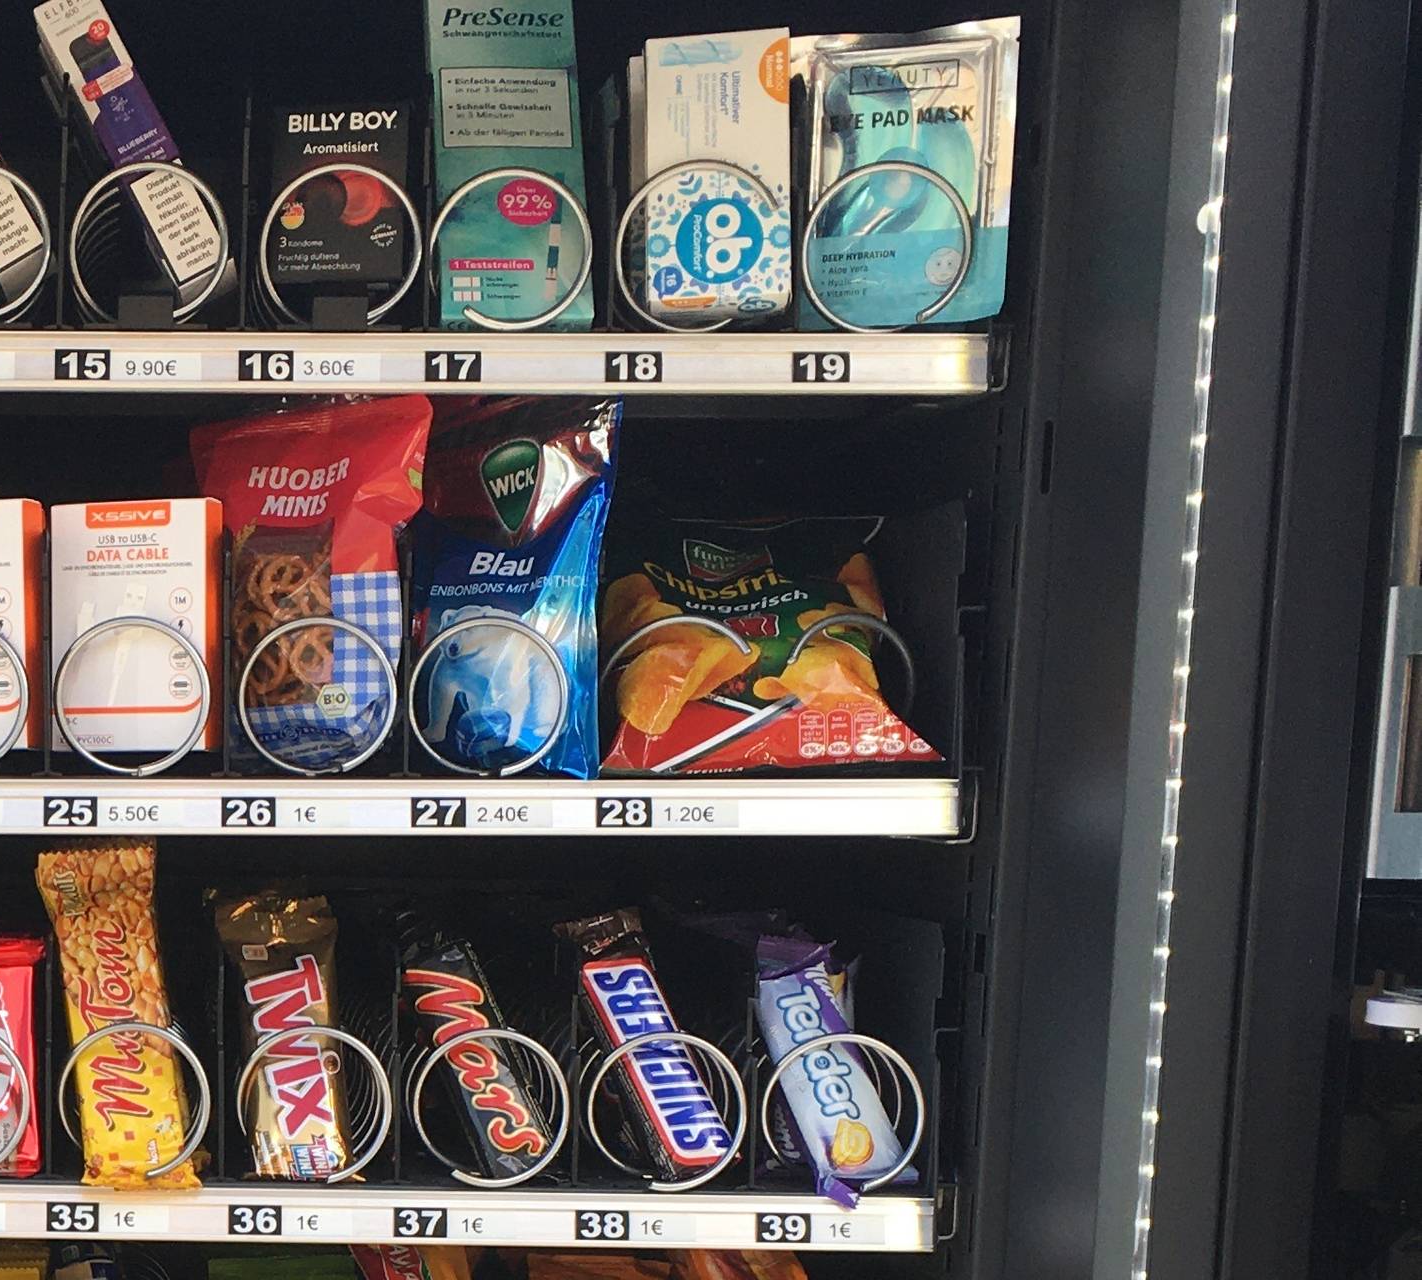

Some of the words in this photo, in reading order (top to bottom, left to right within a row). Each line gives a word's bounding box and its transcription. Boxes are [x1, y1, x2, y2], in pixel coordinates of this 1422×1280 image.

[443, 7, 564, 27] PreSense
[455, 77, 496, 86] Einfache
[499, 78, 556, 87] Anwendung
[456, 103, 496, 111] Schnelle
[871, 110, 909, 129] PAD
[916, 105, 975, 124] MASK
[288, 112, 345, 133] BILLY
[349, 110, 398, 130] BOY
[117, 128, 158, 154] BLUEBERRY
[303, 141, 379, 155] Aromatisiert
[279, 237, 287, 248] 3
[692, 214, 703, 271] ProComfort
[465, 261, 530, 269] Teststreifen
[822, 253, 844, 263] DEEP
[845, 250, 896, 263] HYDRATION
[60, 352, 106, 379] 15
[125, 360, 177, 376] 9.90€
[245, 353, 290, 380] 16
[303, 360, 355, 376] 3.60€
[430, 353, 477, 380] 17
[611, 353, 658, 381] 18
[798, 353, 845, 381] 19
[247, 457, 350, 492] HUOBER
[488, 465, 536, 499] WICK
[91, 509, 166, 522] XSSIVE
[261, 492, 329, 518] MINIS
[98, 535, 116, 545] USB
[130, 533, 157, 543] USB-C
[86, 549, 123, 563] DATA
[126, 547, 169, 561] CABLE
[469, 551, 535, 577] Blau
[506, 583, 529, 594] MIT
[685, 590, 809, 613] ungarisch
[47, 799, 94, 825] 25
[108, 805, 160, 822] 5.50€
[225, 799, 272, 825] 26
[295, 806, 317, 823] 1€
[415, 799, 462, 826] 27
[477, 806, 529, 822] 2.40€
[600, 799, 648, 826] 28
[664, 806, 716, 822] 1.20€
[401, 968, 545, 1155] Mars
[593, 968, 734, 1150] SNICKERS
[778, 985, 861, 1120] Tender
[50, 1204, 95, 1231] 35
[114, 1211, 136, 1228] 1€
[232, 1208, 278, 1234] 36
[297, 1214, 320, 1231] 1€
[398, 1210, 443, 1236] 37
[462, 1218, 484, 1234] 1€
[580, 1212, 624, 1239] 38
[641, 1219, 663, 1236] 1€
[761, 1215, 807, 1241] 39
[829, 1222, 852, 1239] 1€
